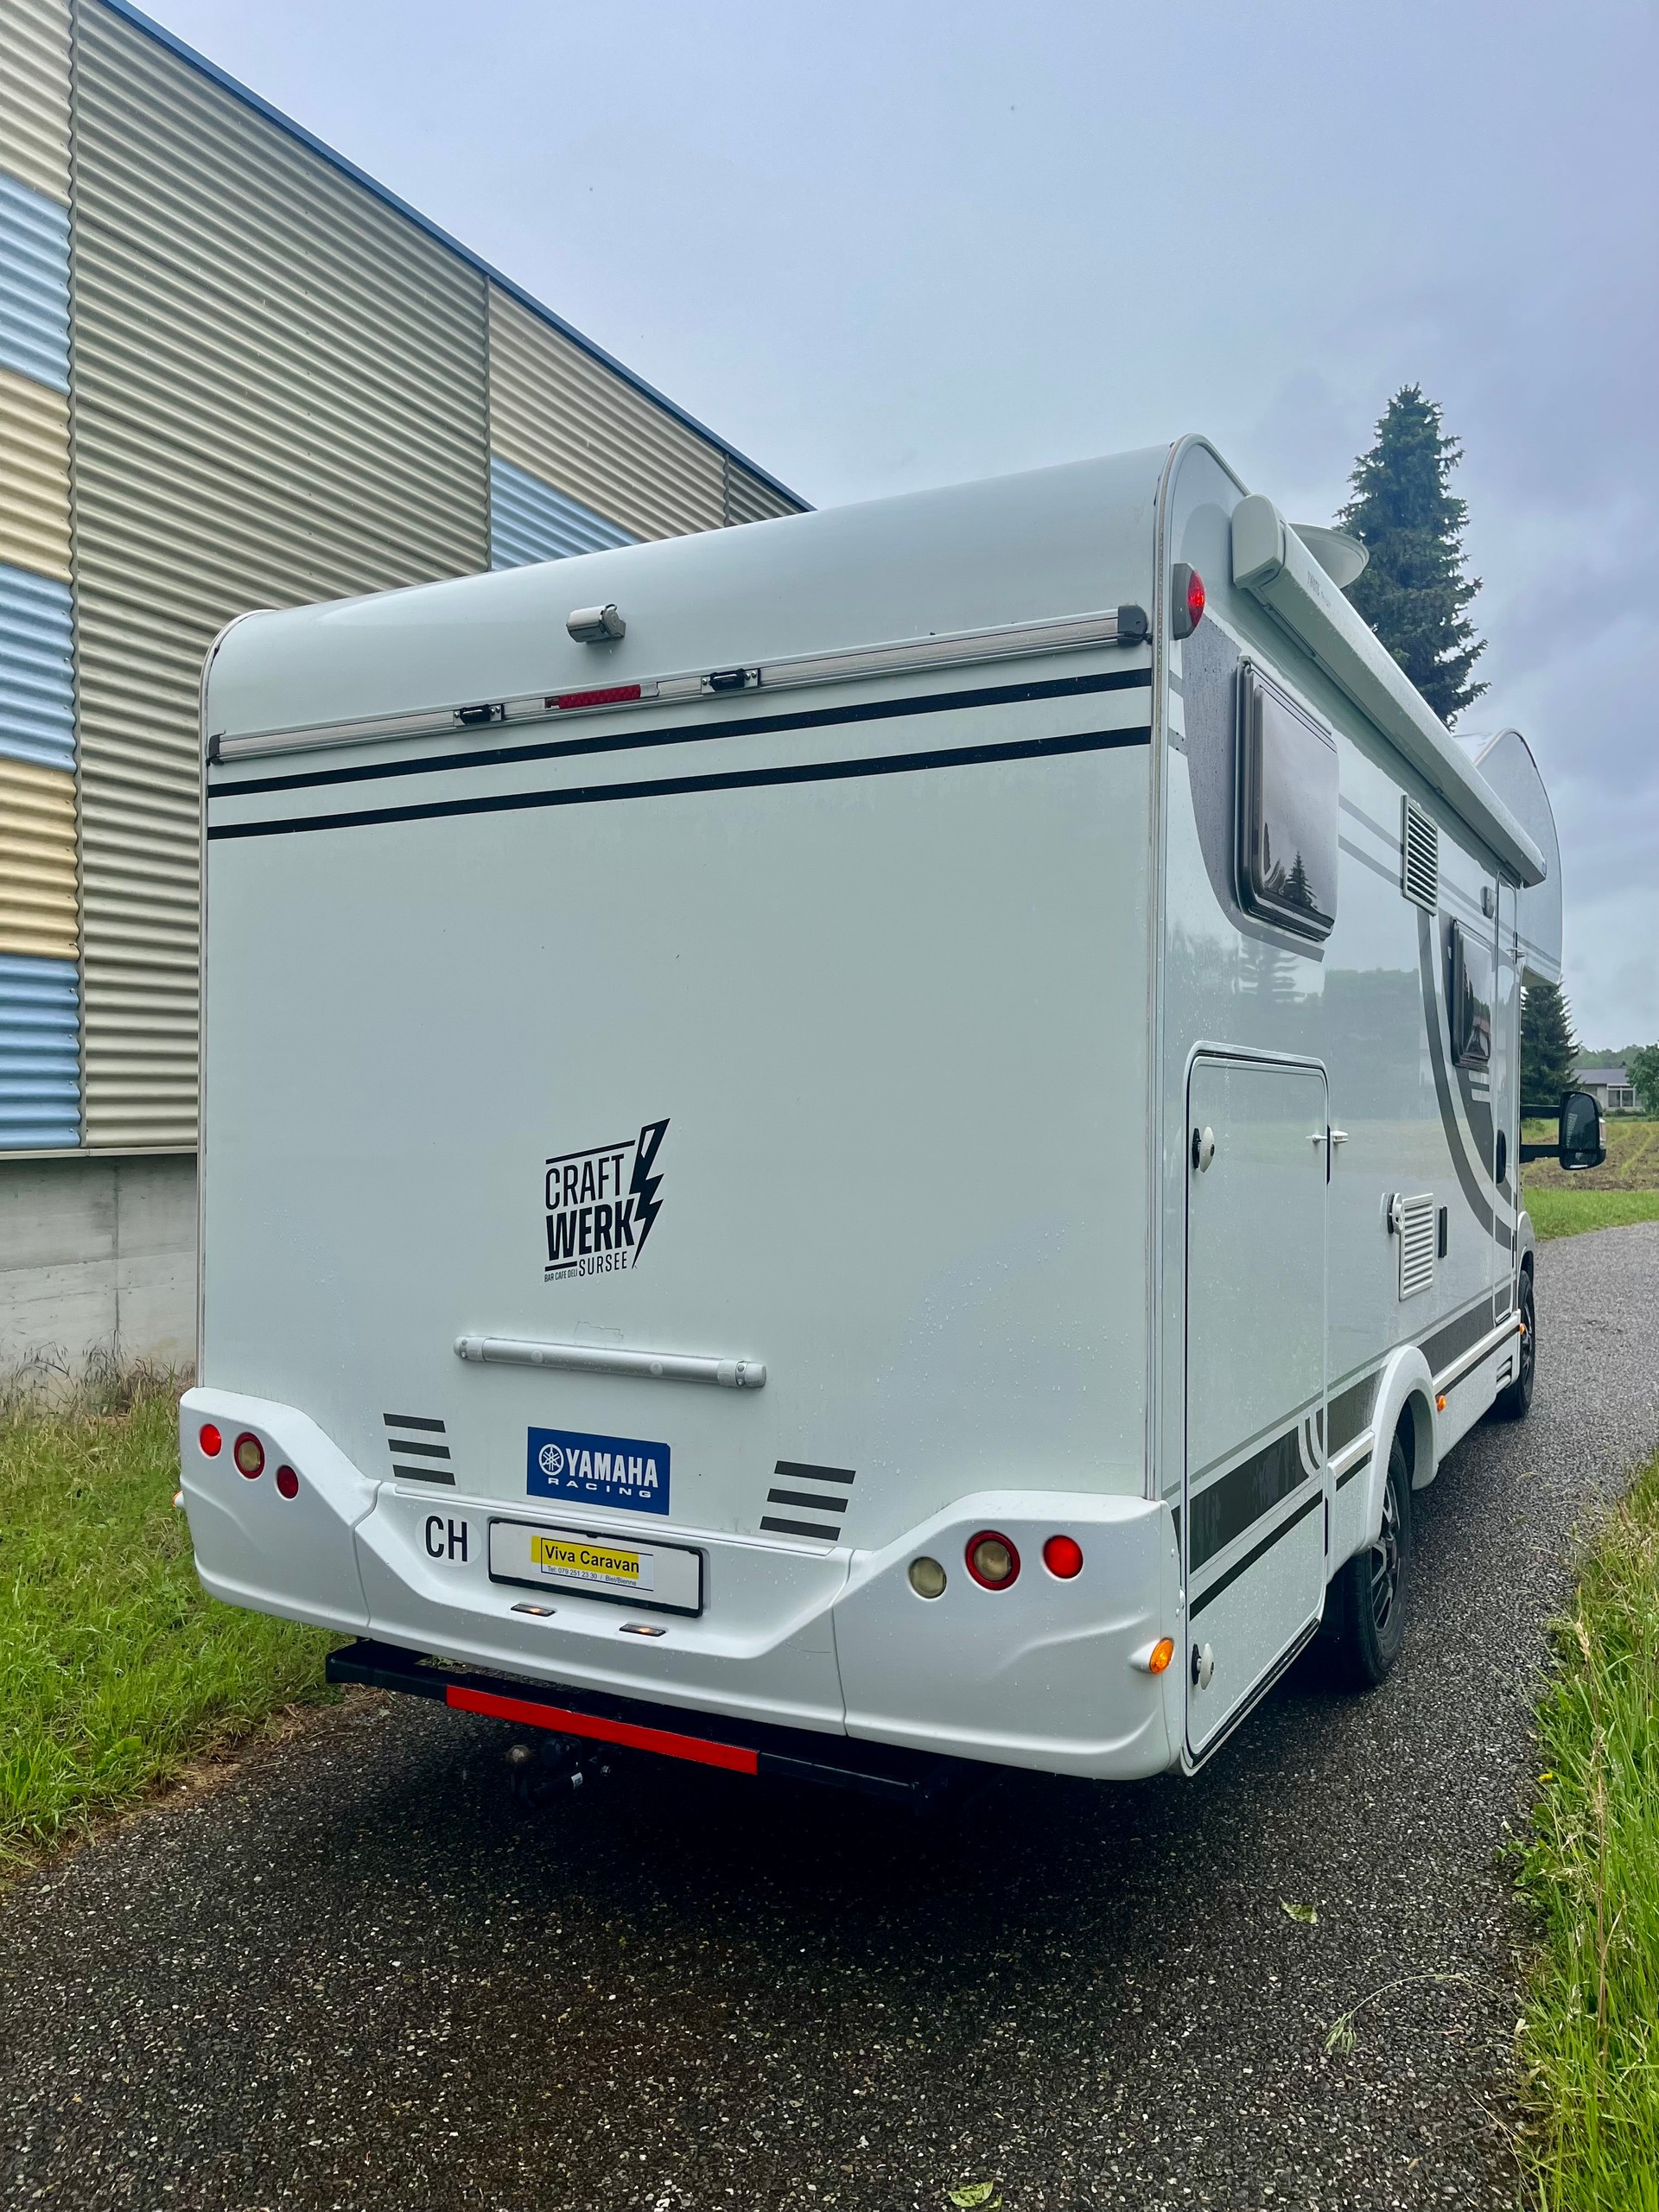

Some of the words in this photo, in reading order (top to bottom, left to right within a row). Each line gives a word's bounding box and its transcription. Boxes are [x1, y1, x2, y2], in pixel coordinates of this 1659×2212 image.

[545, 1154, 624, 1210] CRAFT
[546, 1198, 635, 1261] WERK
[544, 1274, 554, 1282] BAR
[567, 1268, 578, 1279] DELI
[579, 1251, 627, 1276] SURSEE
[566, 1448, 658, 1488] YAMAHA
[548, 1478, 651, 1498] RACING
[425, 1516, 468, 1561] CH
[544, 1544, 575, 1562] Viva
[580, 1550, 639, 1573] Caravan
[605, 1575, 637, 1586] Biel/Bienne
